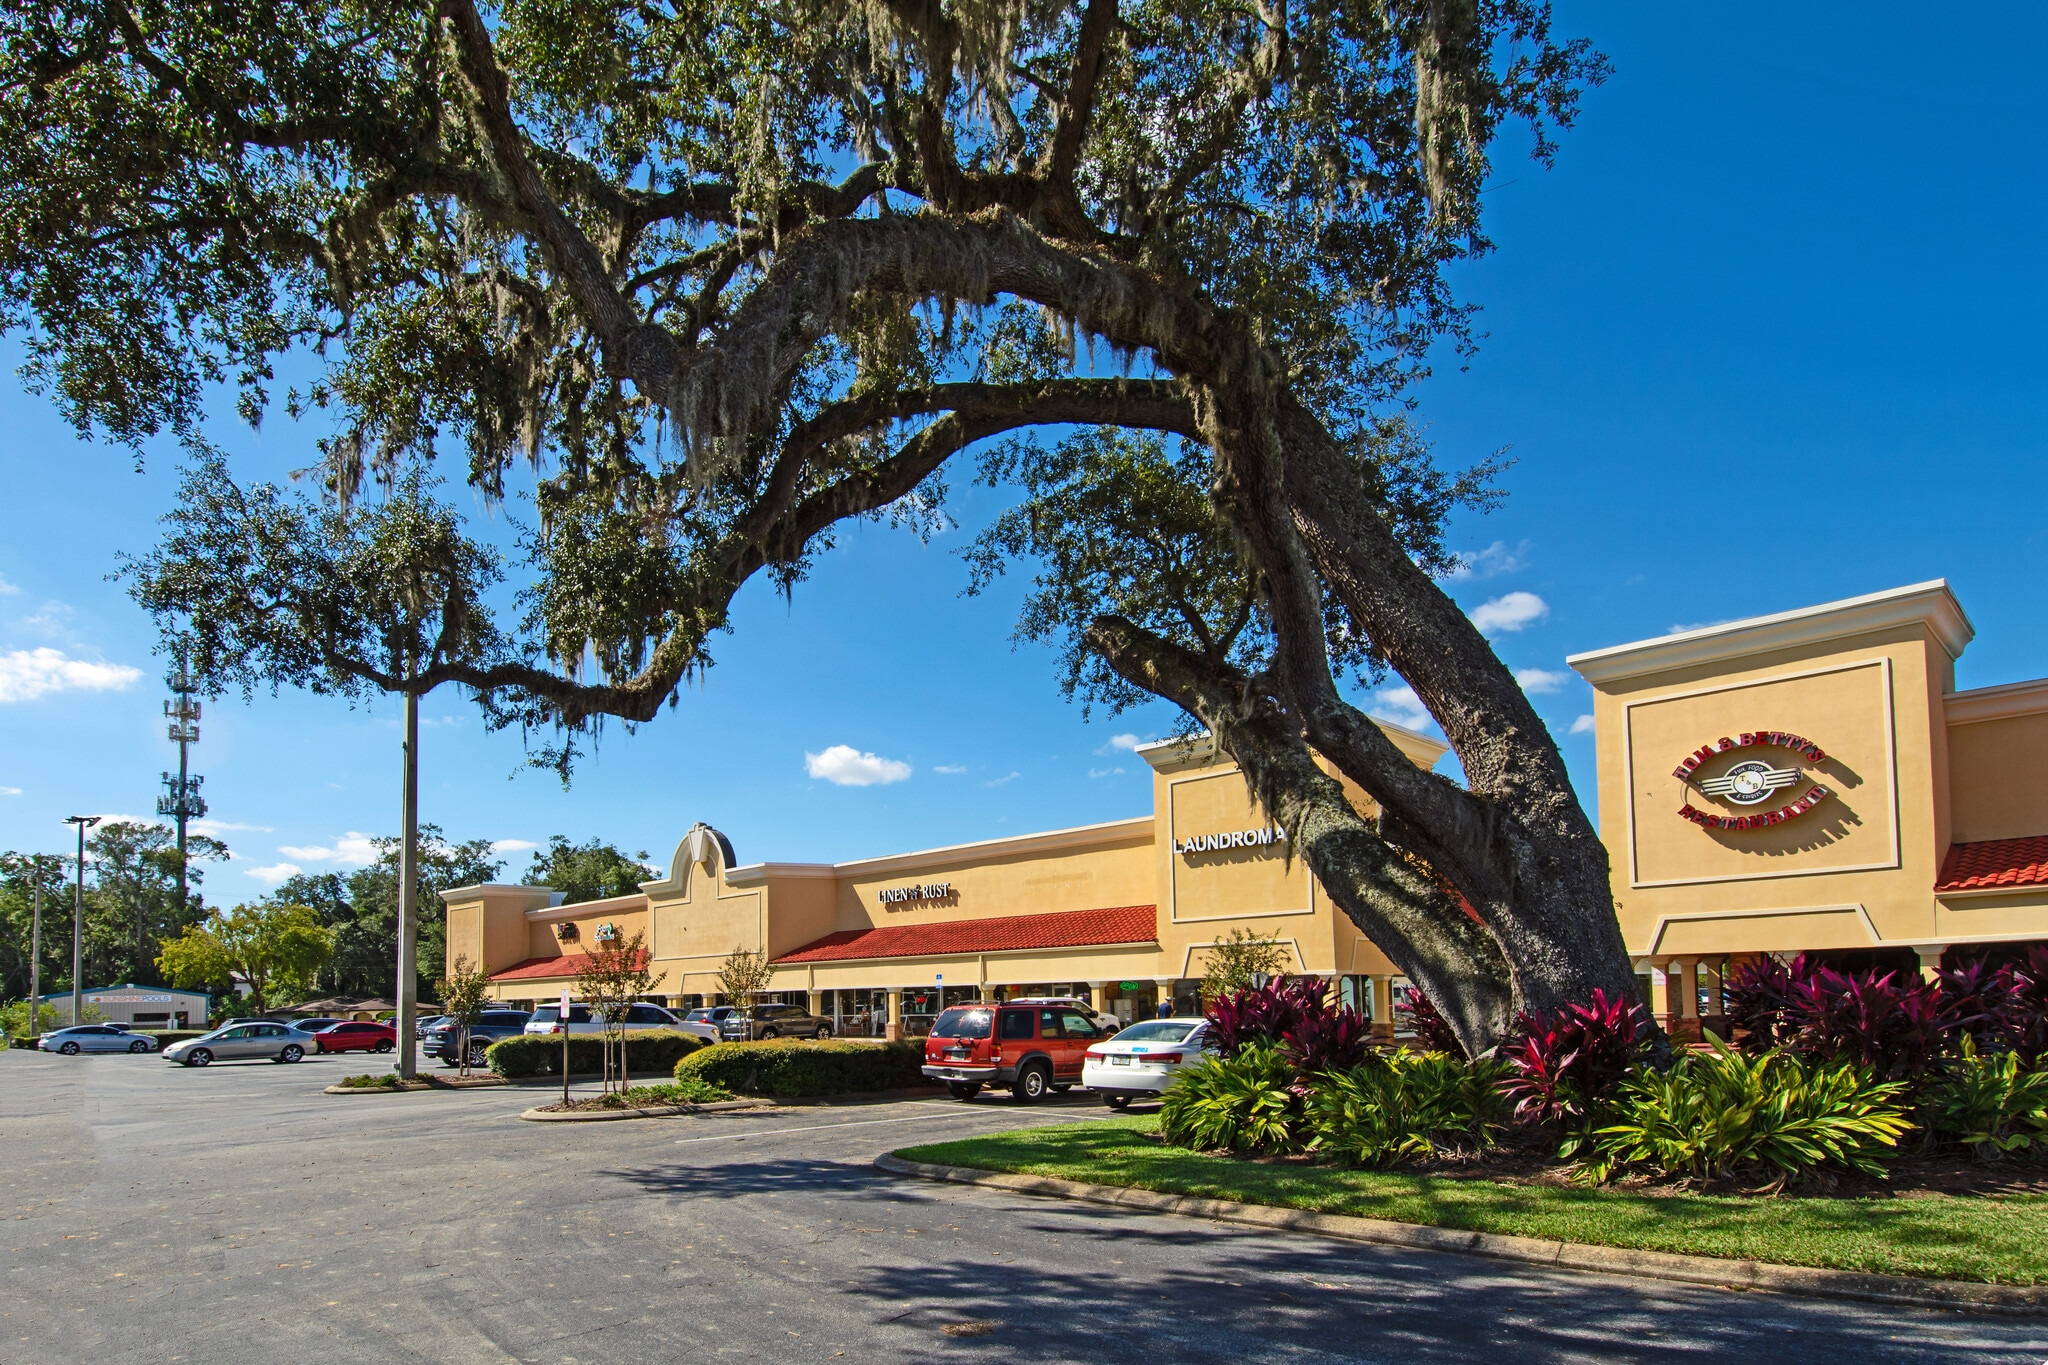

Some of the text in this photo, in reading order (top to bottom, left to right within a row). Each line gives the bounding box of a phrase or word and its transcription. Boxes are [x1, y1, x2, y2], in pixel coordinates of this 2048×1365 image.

[1672, 731, 1826, 779] TOM & BETTY'S
[1677, 785, 1828, 830] RESTAURANT
[1173, 826, 1288, 854] LAUNDROMA
[877, 887, 909, 904] LINEN
[922, 883, 950, 899] RUST
